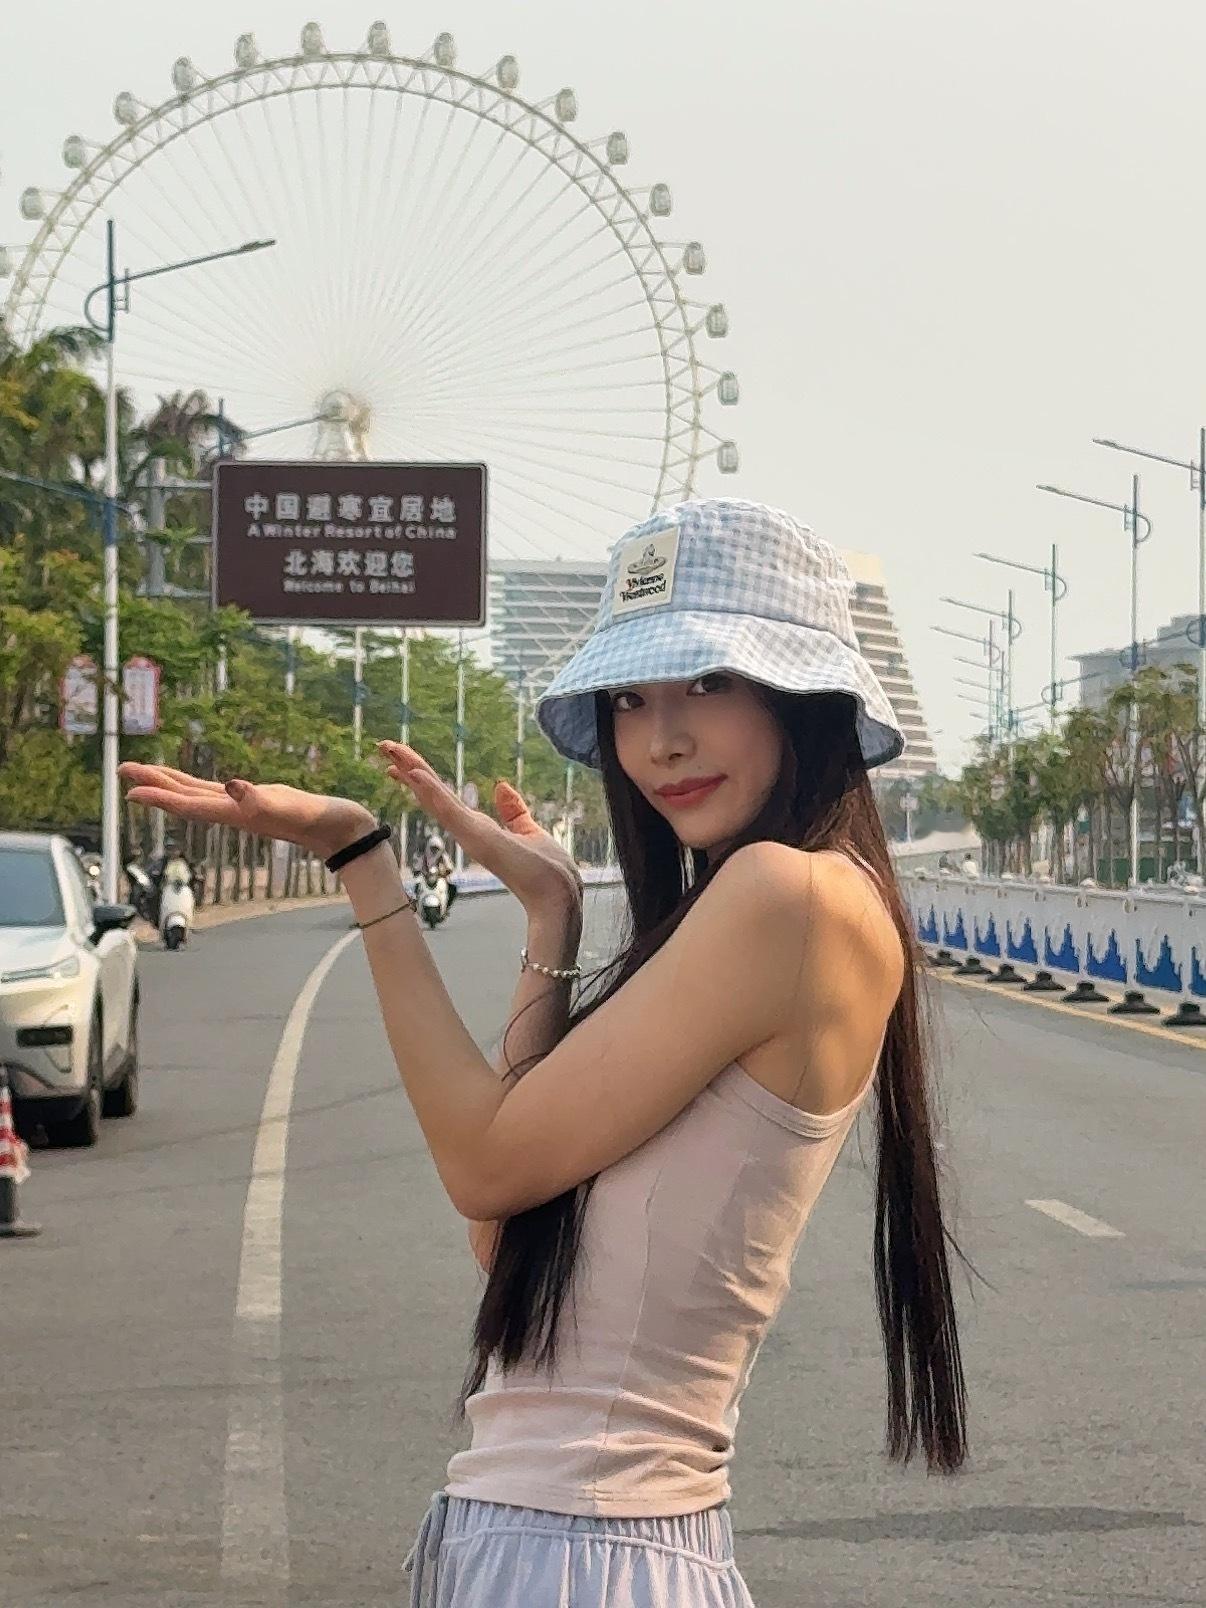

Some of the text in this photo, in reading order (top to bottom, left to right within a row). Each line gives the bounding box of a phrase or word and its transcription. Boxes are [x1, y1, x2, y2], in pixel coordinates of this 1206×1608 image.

[248, 524, 457, 539] A Winter Resort of China
